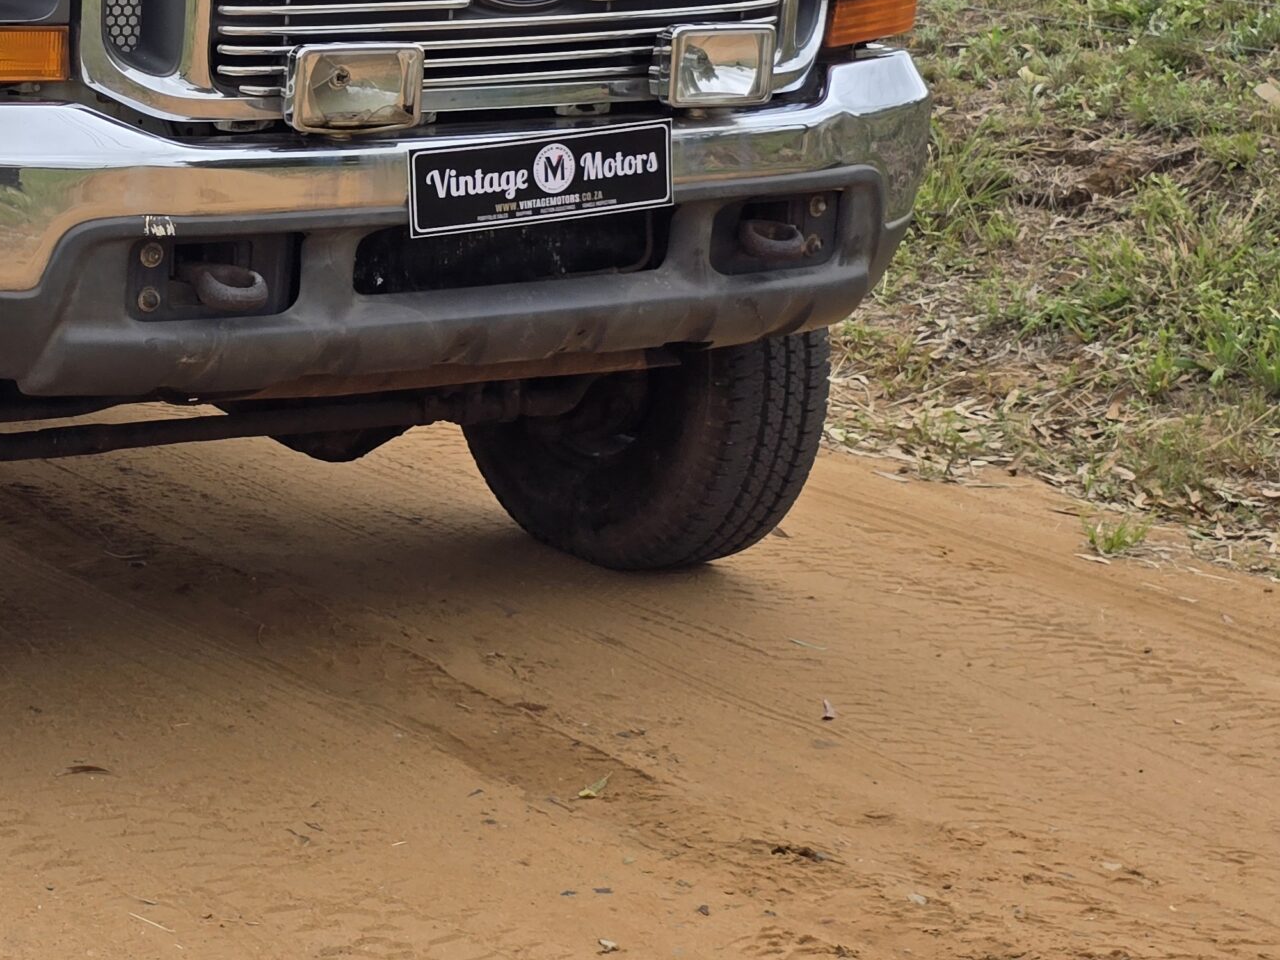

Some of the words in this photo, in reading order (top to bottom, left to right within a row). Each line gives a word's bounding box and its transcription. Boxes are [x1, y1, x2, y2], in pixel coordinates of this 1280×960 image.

[425, 168, 529, 200] Vintage
[579, 151, 658, 181] Motors
[495, 191, 603, 213] WWW.VINTAGEMOTORS.CO.ZA
